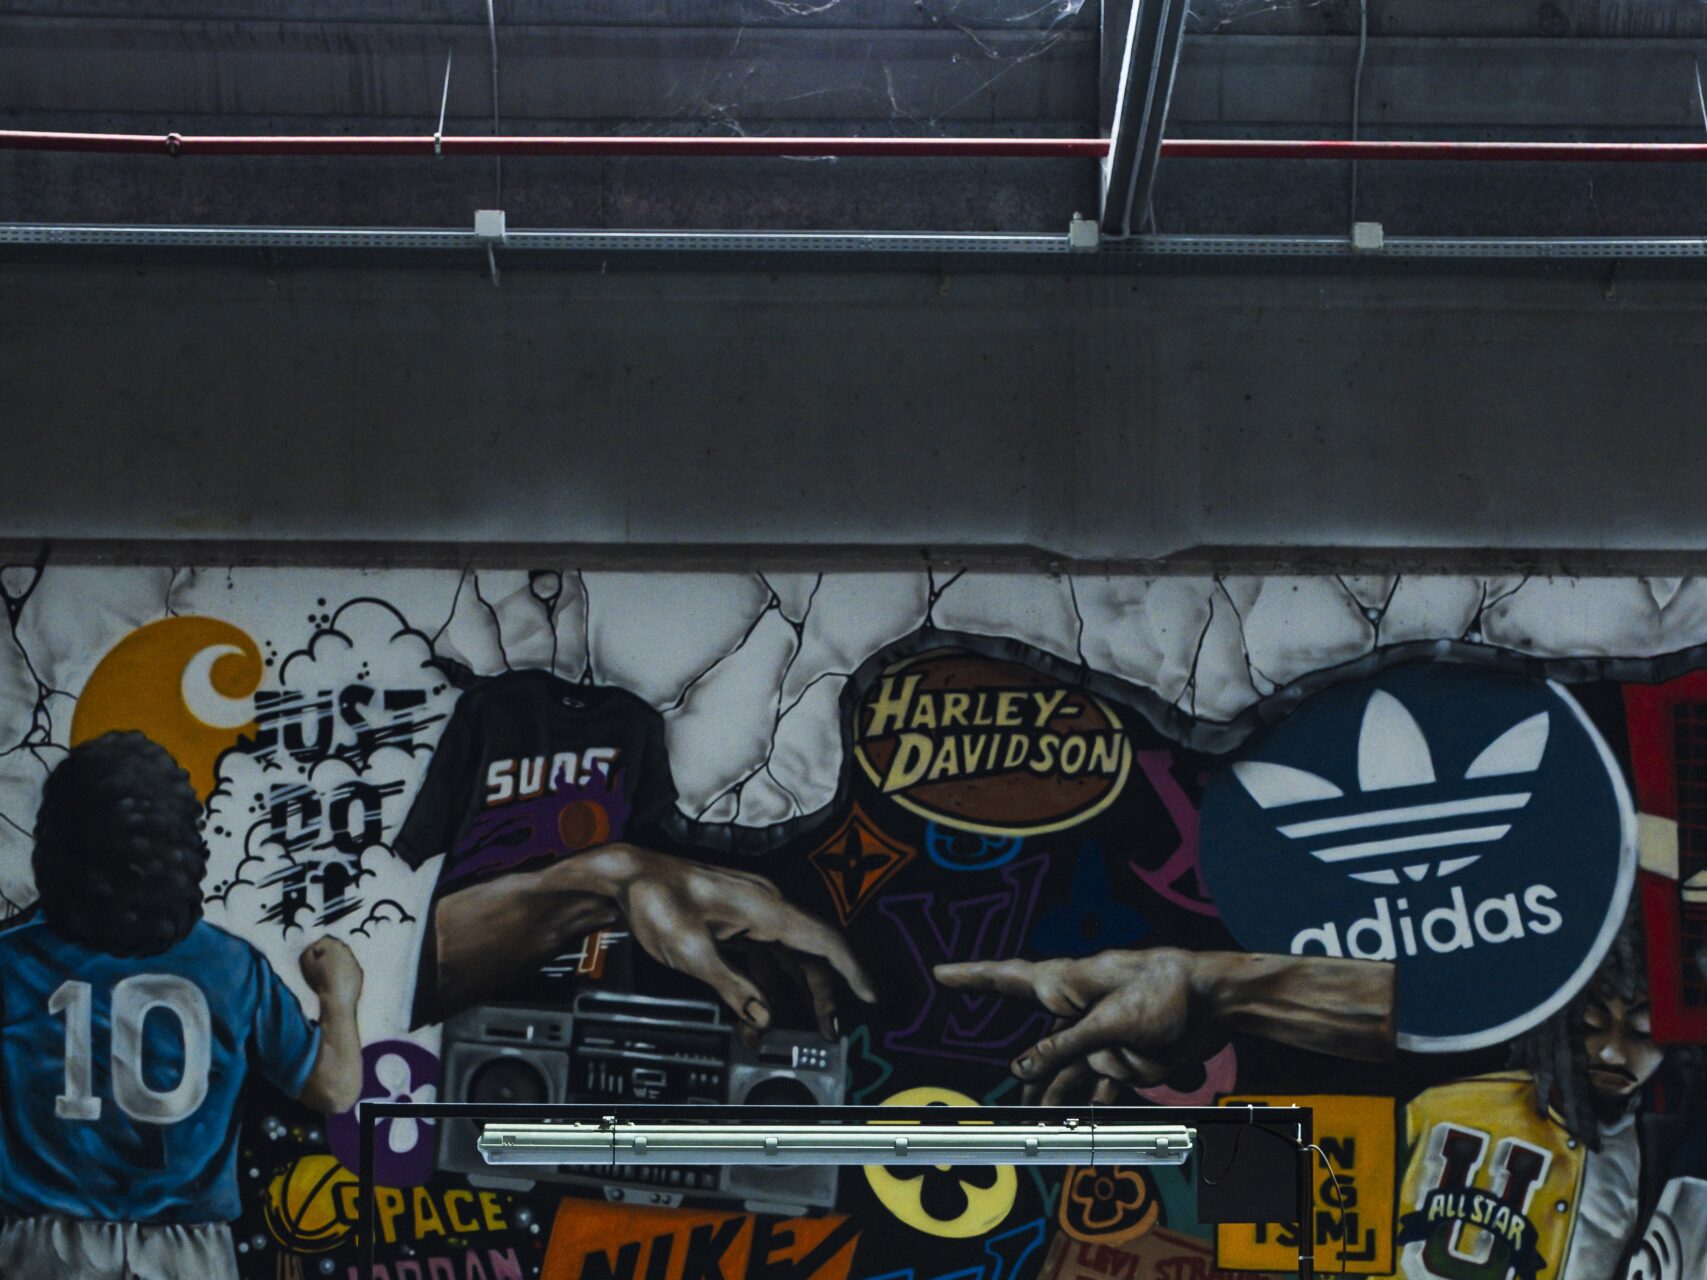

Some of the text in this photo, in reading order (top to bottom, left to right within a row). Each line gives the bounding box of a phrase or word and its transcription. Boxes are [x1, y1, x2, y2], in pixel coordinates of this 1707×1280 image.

[866, 673, 1079, 737] HARLEY-
[882, 731, 1123, 793] DAVIDSON
[1290, 883, 1563, 961] adidas
[48, 973, 211, 1125] 10
[1427, 1193, 1526, 1251] ALL STAR
